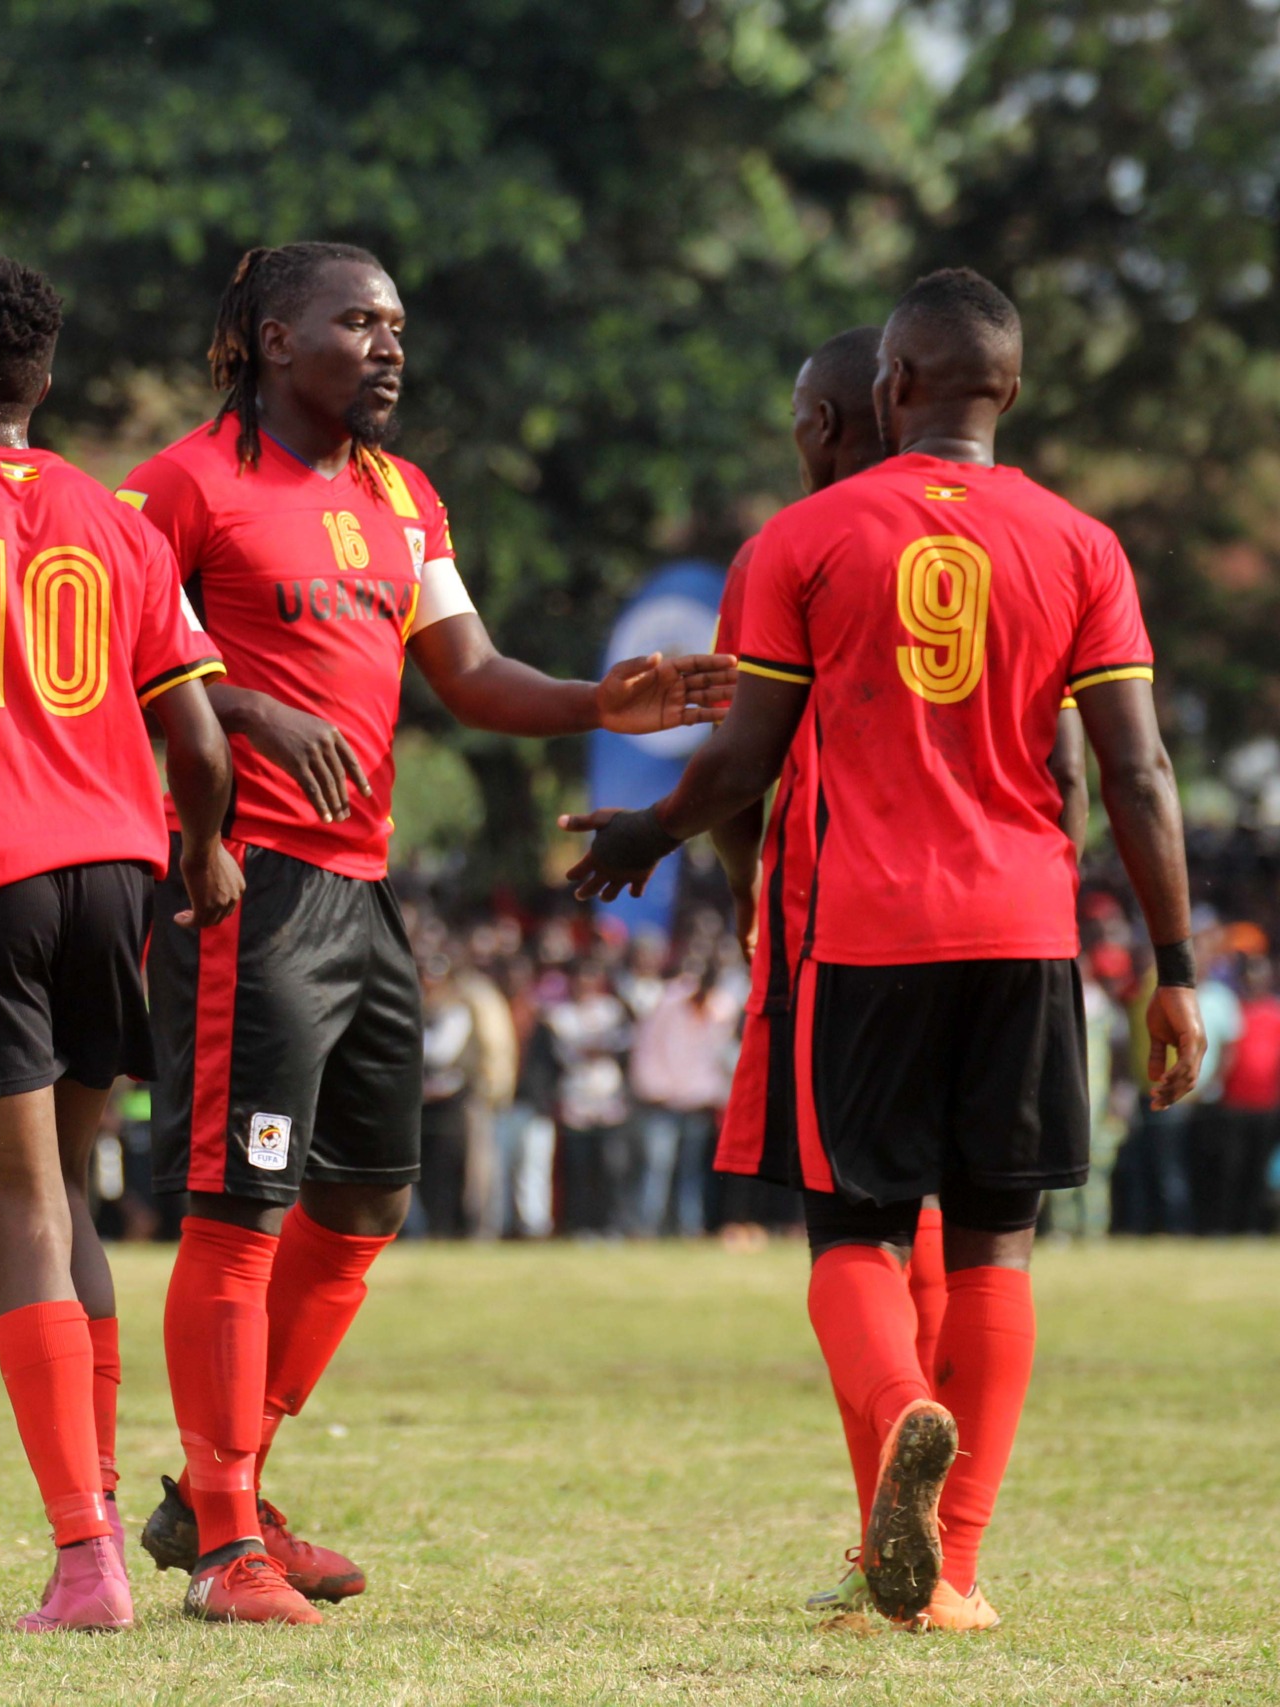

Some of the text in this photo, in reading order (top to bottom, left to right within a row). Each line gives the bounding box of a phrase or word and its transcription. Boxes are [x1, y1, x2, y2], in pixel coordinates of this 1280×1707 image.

[322, 511, 370, 570] 16
[275, 578, 410, 623] UGANDA
[896, 535, 992, 704] 9
[257, 1154, 279, 1163] FUFA
